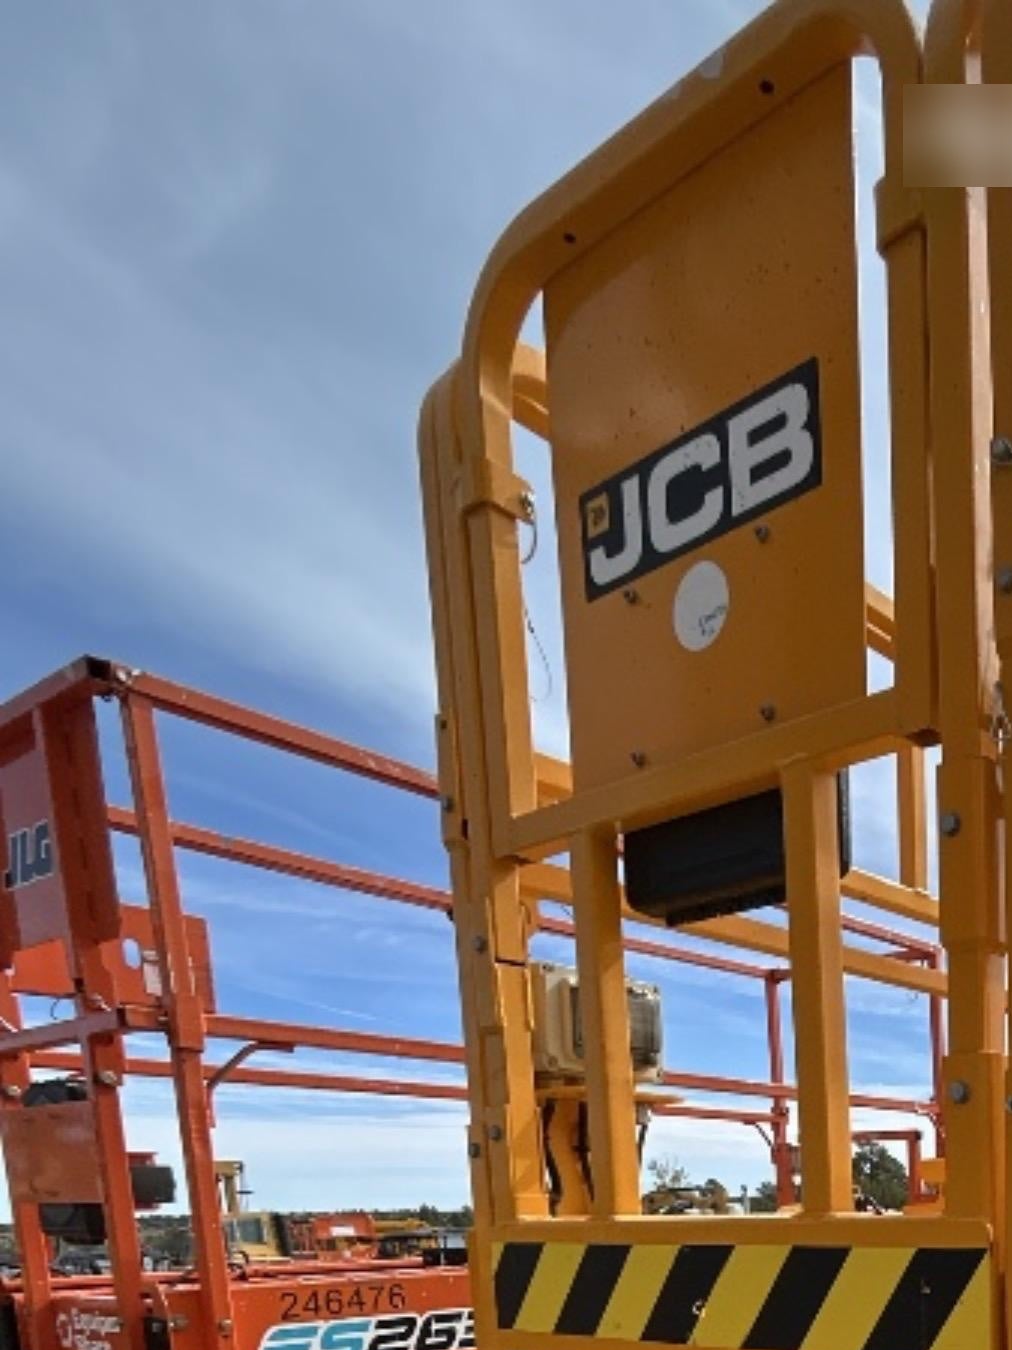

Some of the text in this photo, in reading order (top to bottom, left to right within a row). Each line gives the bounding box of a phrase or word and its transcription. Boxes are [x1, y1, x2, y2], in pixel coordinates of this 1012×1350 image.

[589, 383, 815, 586] JCB
[5, 820, 52, 890] JLG
[280, 1283, 406, 1321] 246476
